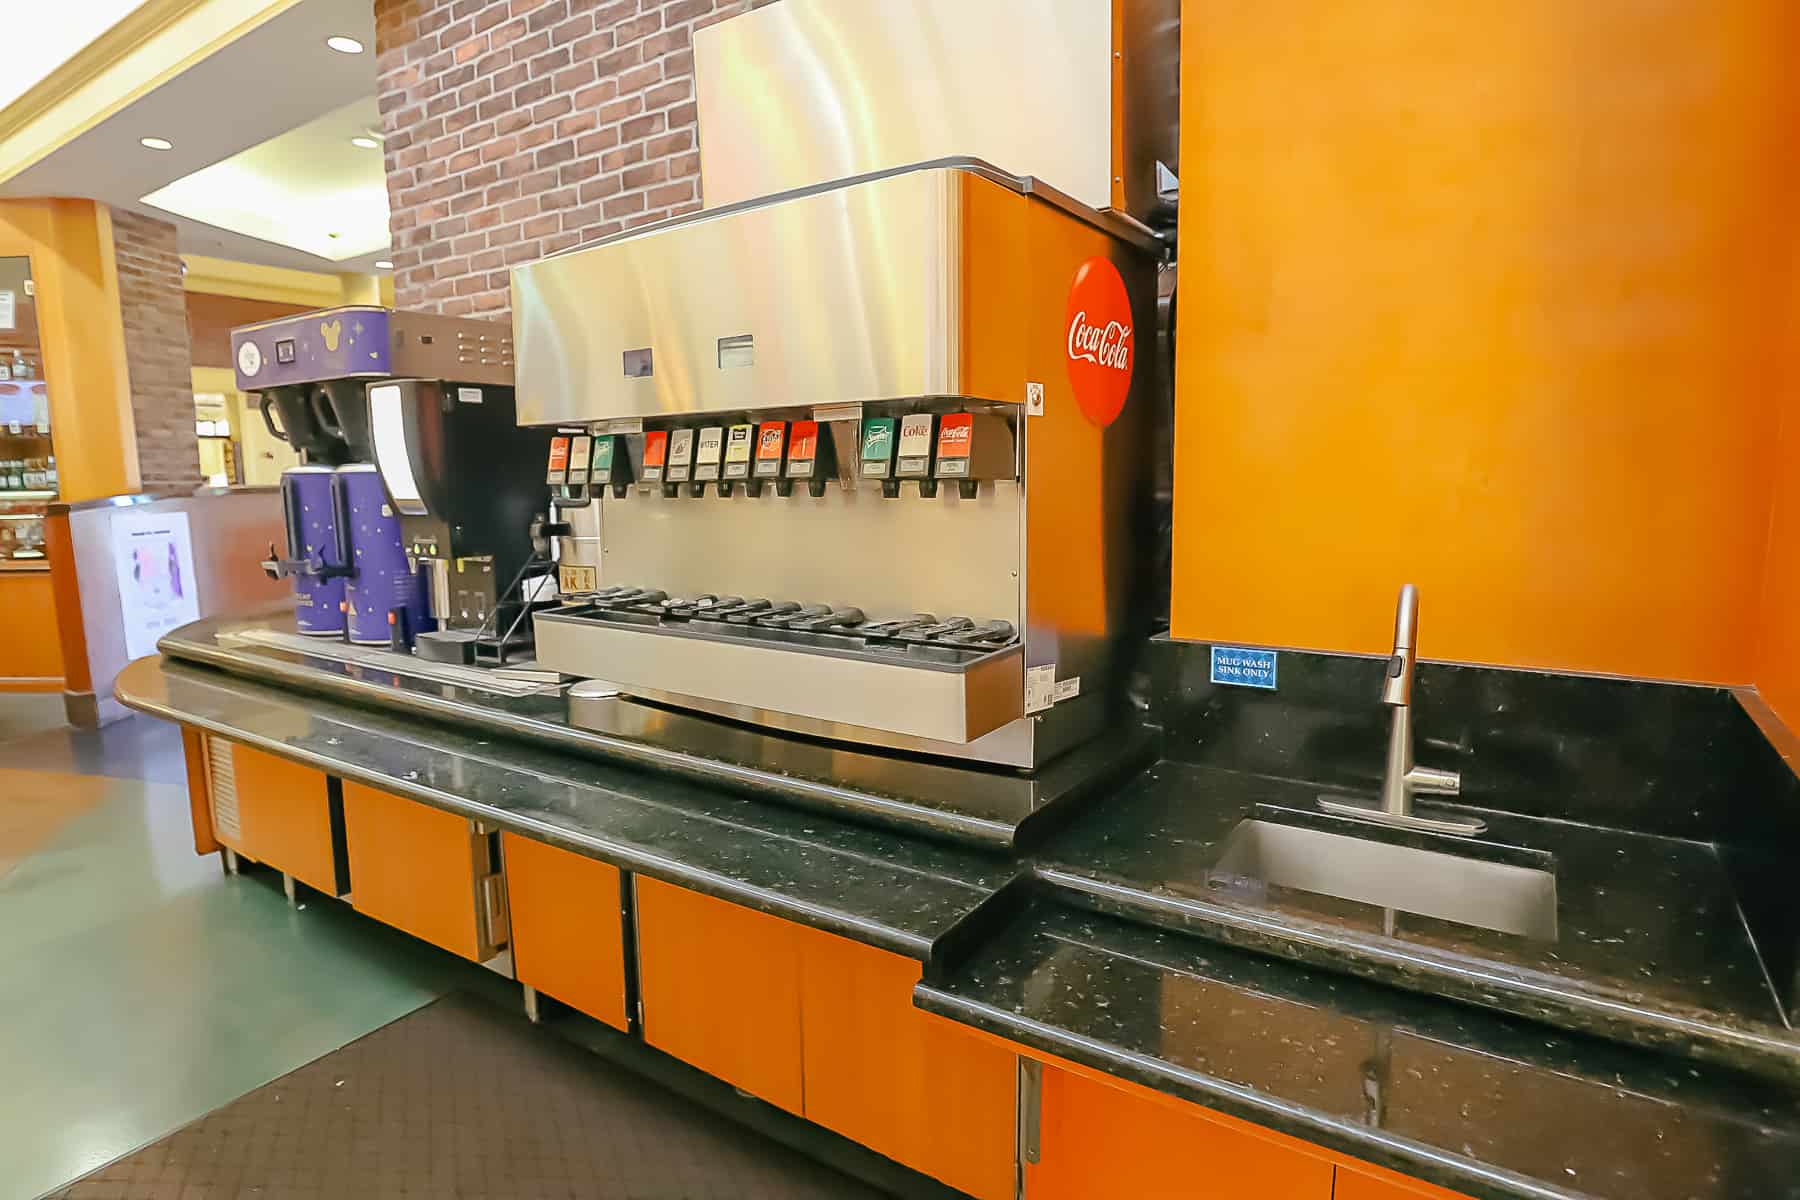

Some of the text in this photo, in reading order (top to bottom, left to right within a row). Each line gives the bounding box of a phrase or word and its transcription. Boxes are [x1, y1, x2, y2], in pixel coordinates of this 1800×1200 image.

[1068, 311, 1131, 370] Coca-Cola
[903, 425, 929, 438] Coke
[1216, 656, 1271, 669] MUG WASH
[1217, 665, 1269, 678] SINK ONLY
